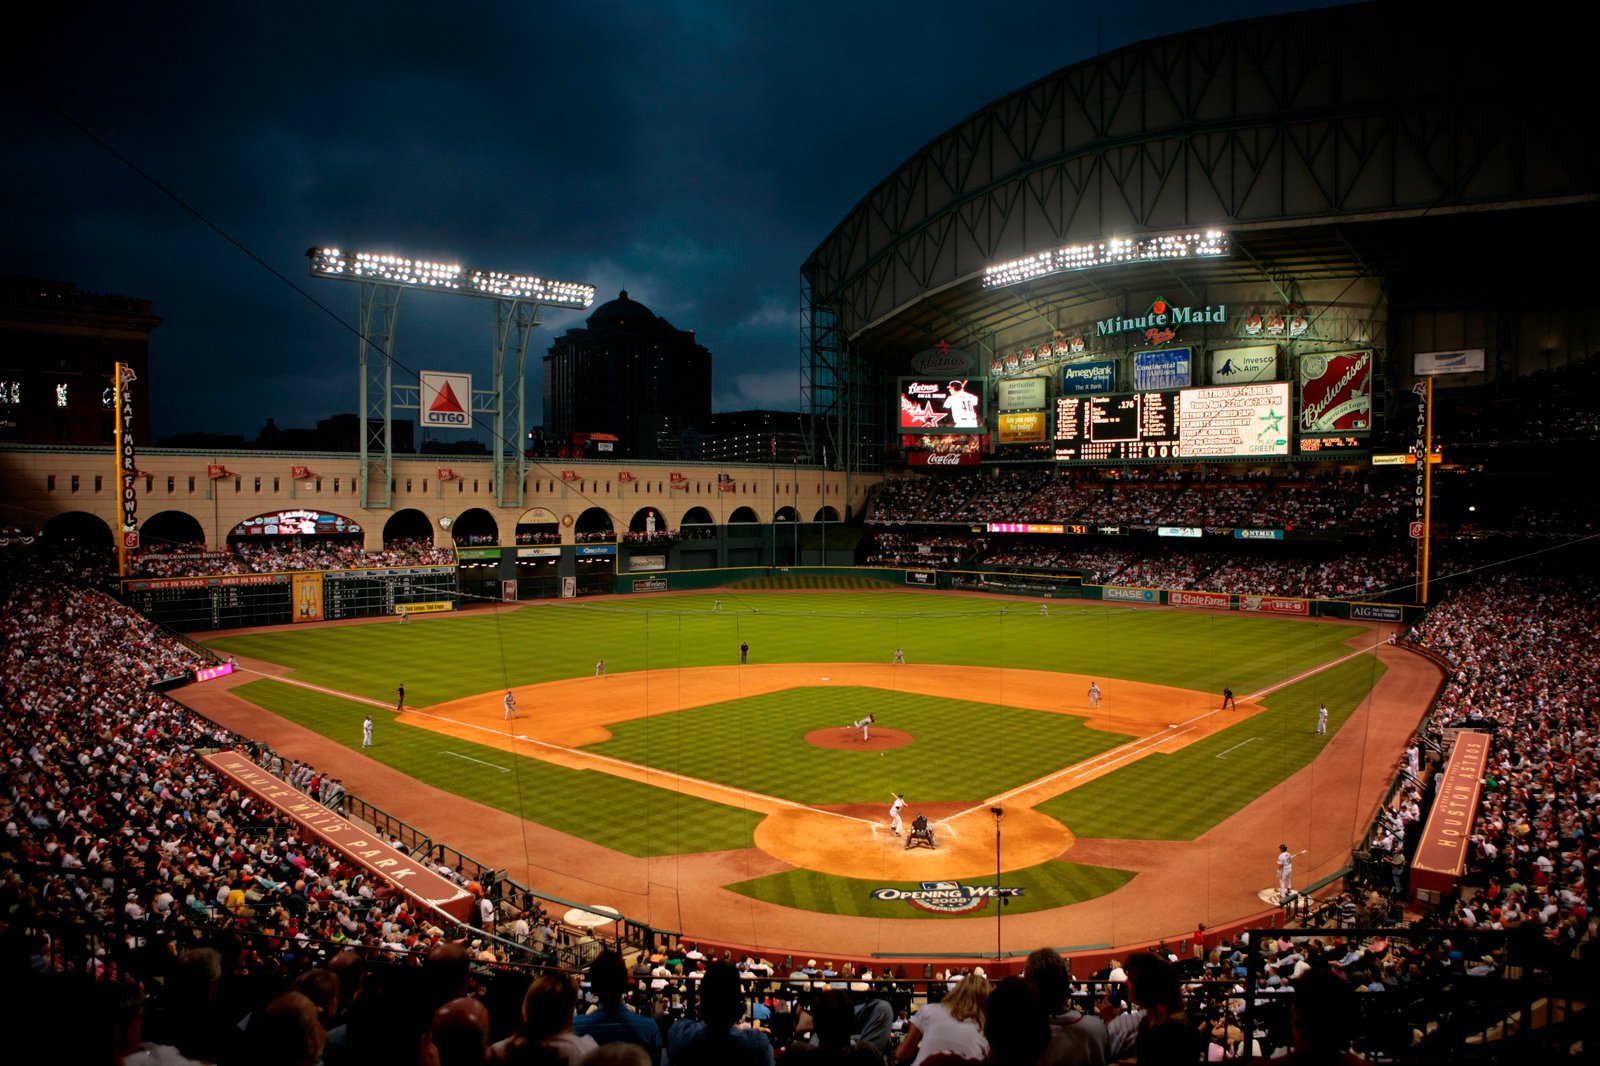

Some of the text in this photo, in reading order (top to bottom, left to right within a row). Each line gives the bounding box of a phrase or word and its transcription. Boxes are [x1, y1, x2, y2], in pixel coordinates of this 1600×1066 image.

[1096, 305, 1226, 337] Minute Maid
[920, 354, 965, 369] Astros
[1136, 362, 1175, 371] Continental
[1243, 356, 1274, 364] Invesco
[1066, 366, 1112, 379] AmegyBank
[1150, 368, 1175, 376] Airlines
[908, 382, 939, 395] Astros
[1198, 389, 1227, 399] ASTROS
[1241, 386, 1273, 396] PADRES
[1300, 351, 1370, 427] Budweiser
[961, 400, 972, 412] 46
[1226, 399, 1244, 407] 22nd
[1270, 396, 1282, 405] PM
[428, 411, 465, 423] CITGO
[1322, 400, 1368, 426] American Lager
[1017, 423, 1034, 431] today?
[1148, 446, 1155, 458] 0
[1160, 446, 1167, 458] 0
[1172, 445, 1179, 457] 0
[123, 392, 135, 525] EAT MOR FOWL
[1415, 403, 1425, 518] EAT MOR FOWL
[630, 560, 664, 568] ConocoPhillips
[1108, 589, 1143, 599] CHASE
[1182, 594, 1226, 606] State Farm
[1353, 607, 1371, 616] AIG
[1437, 785, 1472, 848] HOUSTON
[1458, 743, 1481, 779] ASTROS
[224, 762, 288, 798] MINUTE
[288, 803, 344, 833] MAID
[346, 840, 417, 879] PARK
